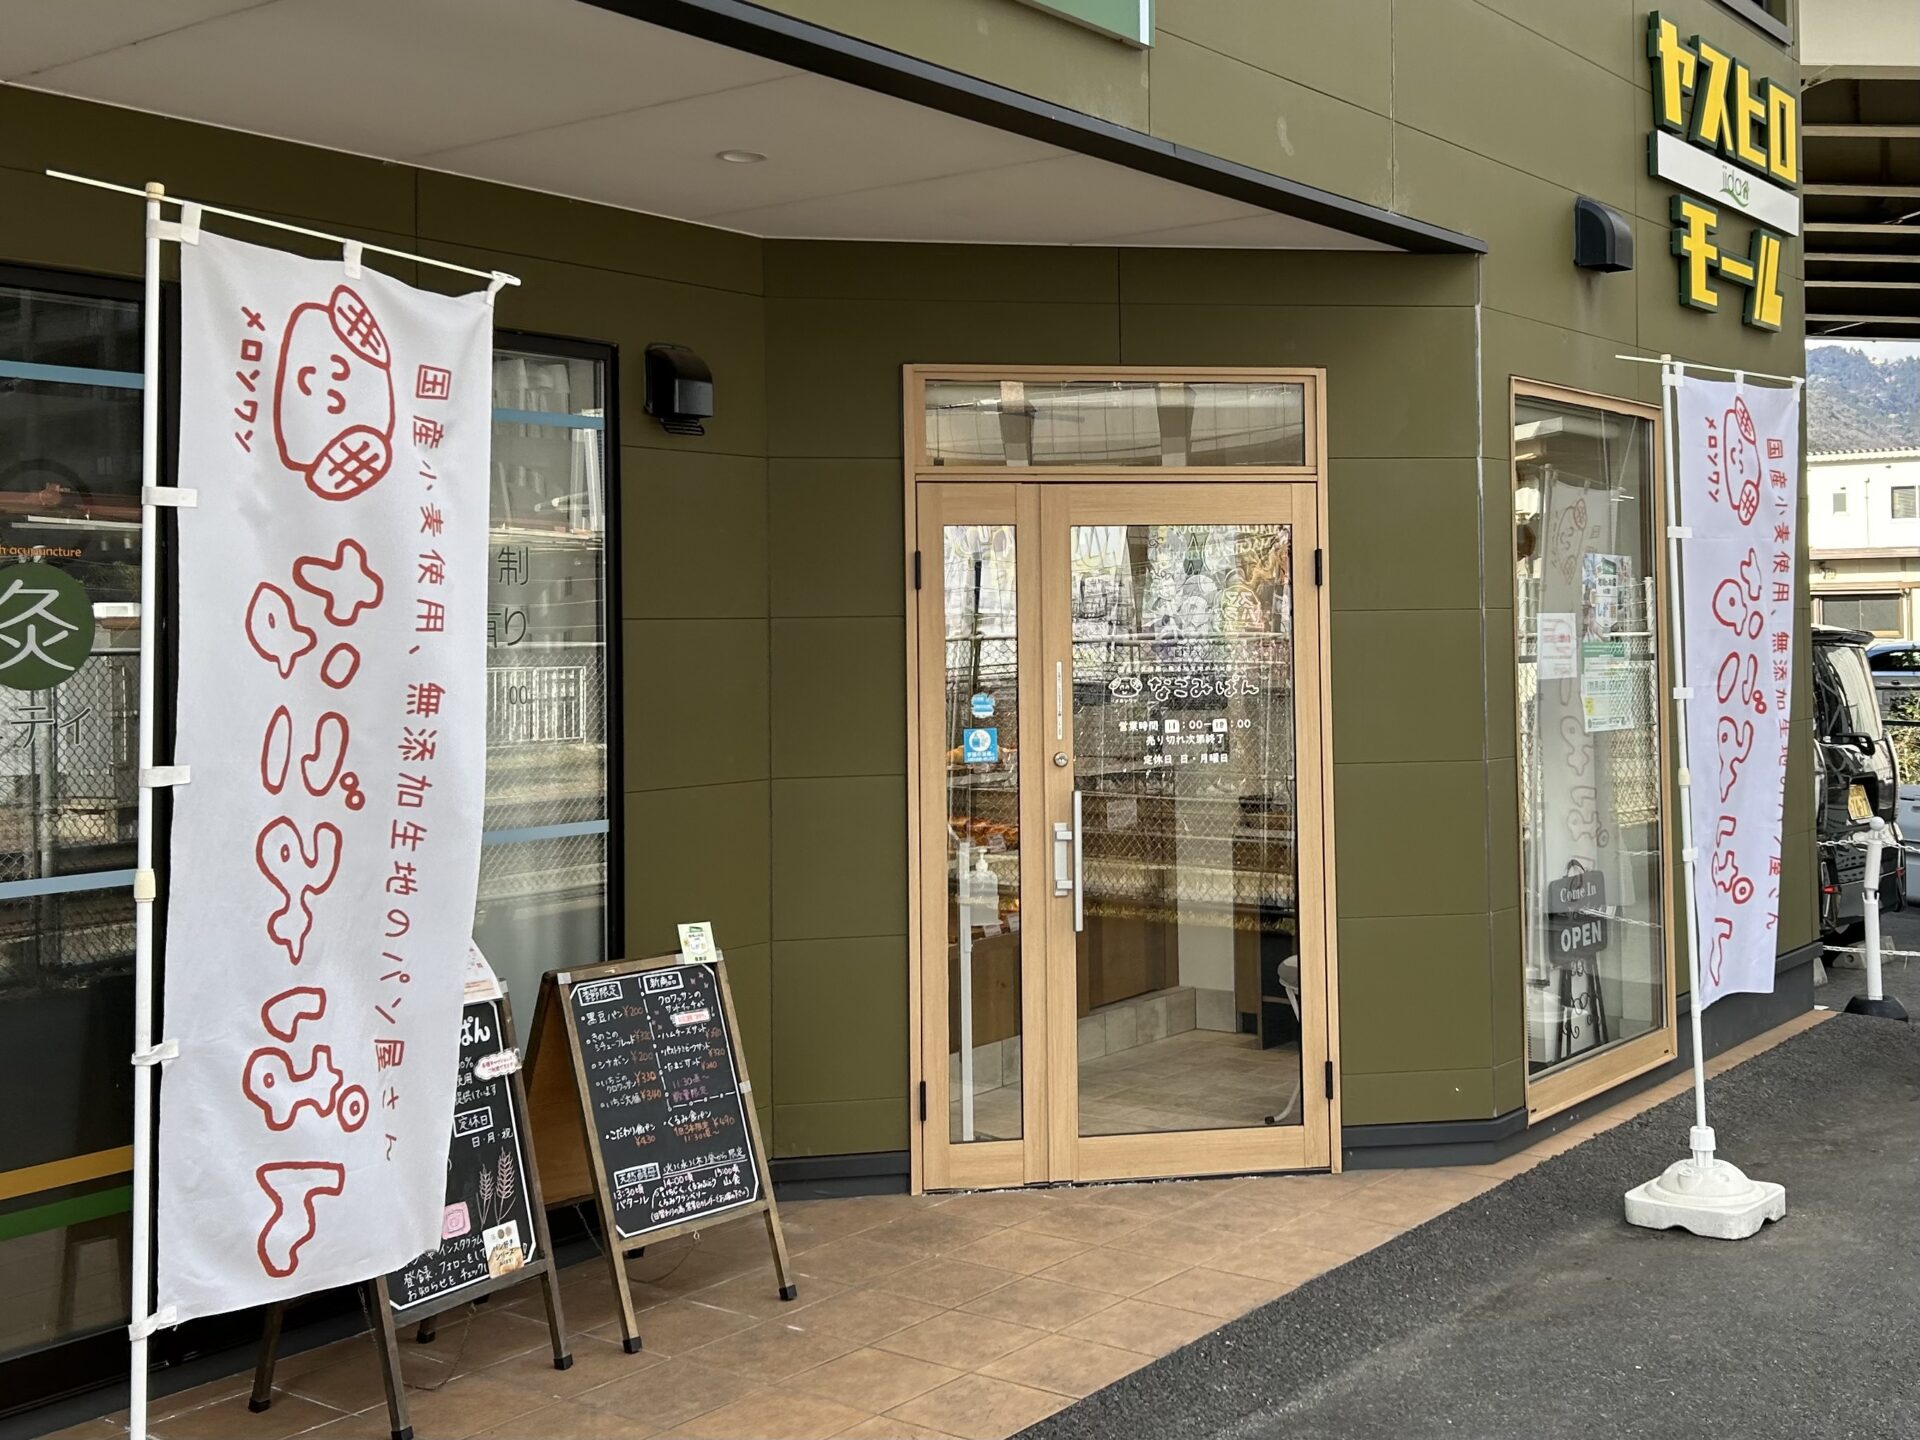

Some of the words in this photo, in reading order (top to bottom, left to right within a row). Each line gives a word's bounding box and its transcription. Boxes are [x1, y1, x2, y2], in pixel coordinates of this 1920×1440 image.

[1650, 12, 1798, 188] ヤスヒロ
[1673, 195, 1784, 331] モール
[235, 306, 265, 453] メロンワン
[9, 546, 82, 558] acupuncture
[1147, 674, 1259, 702] なごみぱん
[1143, 754, 1172, 765] 定休日
[1560, 884, 1586, 903] Come
[1587, 881, 1597, 896] In
[242, 538, 384, 1278] なごみぱん
[1560, 920, 1602, 952] OPEN
[458, 1114, 489, 1131] 定休日
